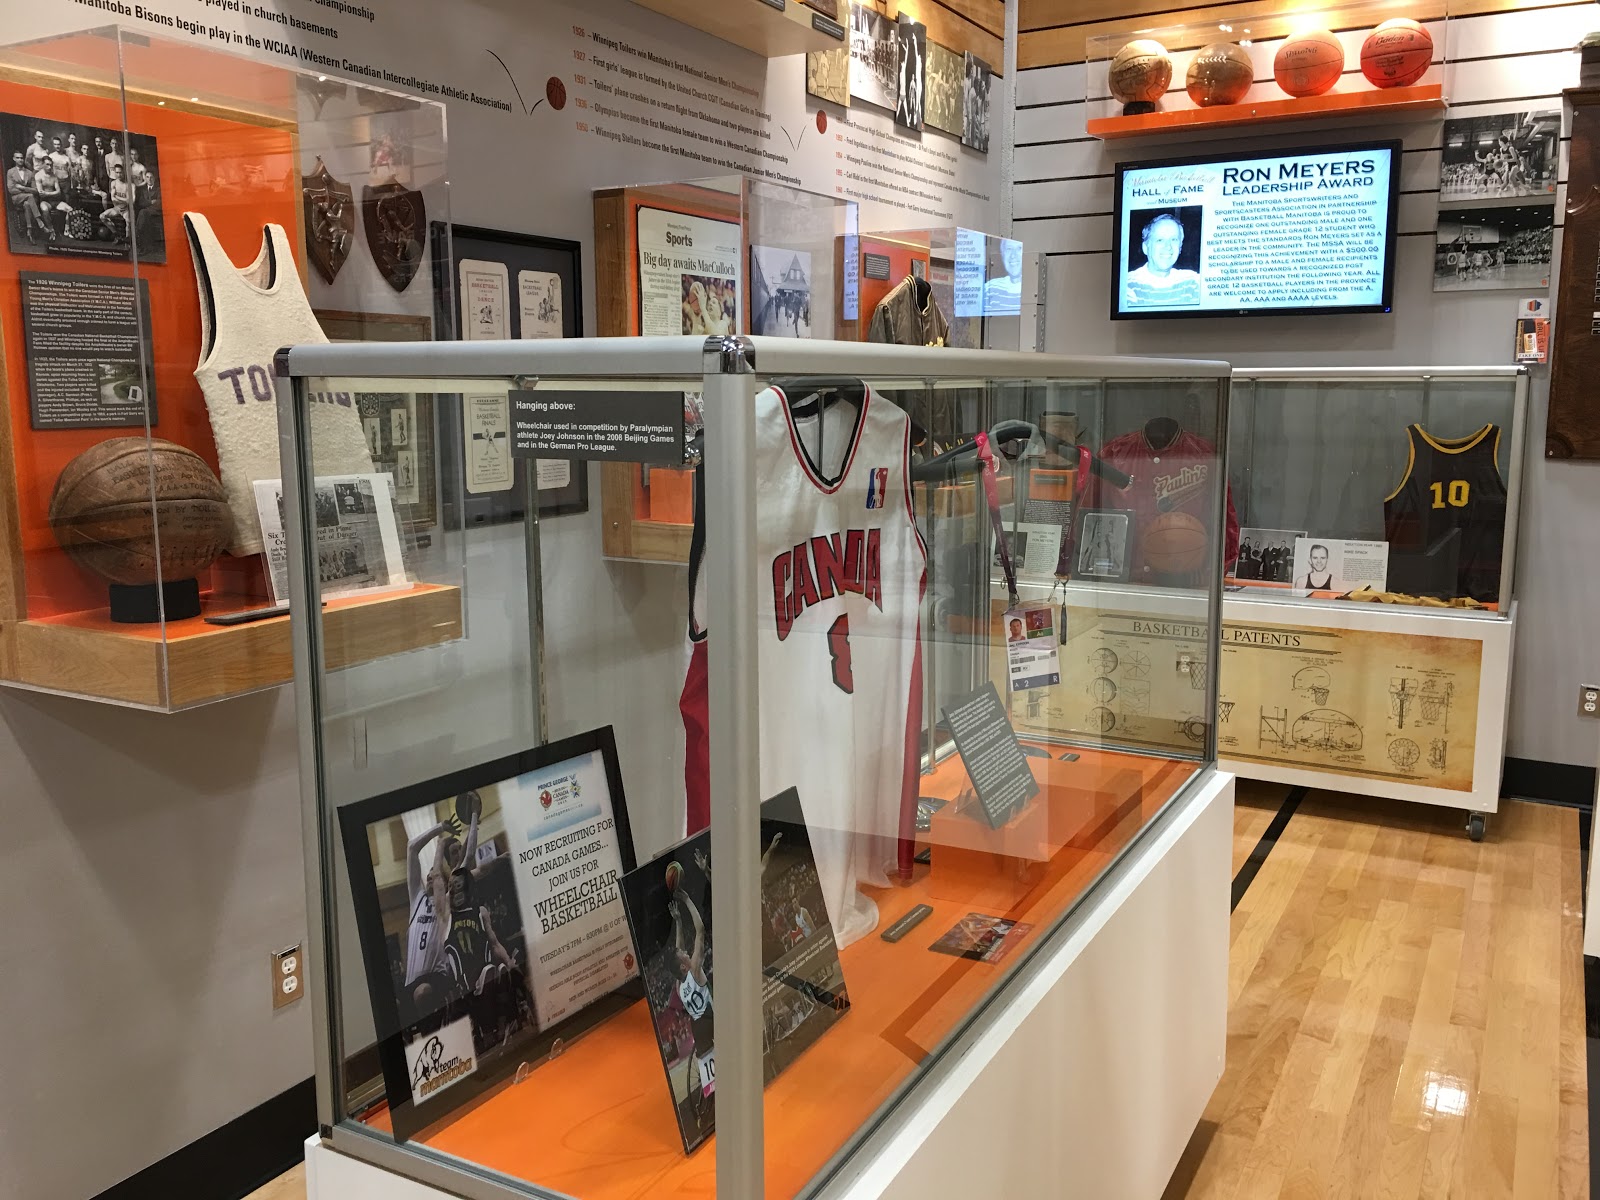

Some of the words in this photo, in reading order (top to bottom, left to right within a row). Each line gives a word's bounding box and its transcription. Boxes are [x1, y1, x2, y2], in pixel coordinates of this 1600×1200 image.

[242, 2, 251, 15] in
[255, 7, 287, 24] church
[290, 15, 338, 38] basements
[135, 5, 173, 26] Bisons
[176, 16, 206, 35] begin
[209, 26, 230, 43] play
[234, 31, 243, 44] in
[245, 35, 260, 48] the
[263, 38, 298, 58] WCIAA
[300, 47, 340, 69] (Western
[342, 59, 381, 79] Canadian
[383, 70, 439, 94] Intercollegiate
[441, 85, 469, 101] Athletic
[471, 93, 512, 113] Association)
[593, 32, 618, 51] Winnipeg
[619, 42, 636, 56] Toilers
[637, 50, 647, 59] win
[675, 61, 684, 72] first
[684, 65, 703, 78] National
[704, 72, 718, 83] Senior
[593, 56, 605, 67] First
[620, 65, 637, 78] league
[596, 126, 621, 143] Winnipeg
[642, 138, 661, 150] become
[670, 146, 679, 155] first
[680, 148, 701, 161] Manitoba
[701, 154, 712, 164] team
[713, 156, 717, 165] to
[734, 162, 752, 173] Canadian
[752, 168, 764, 176] Junior
[777, 172, 802, 186] Championship
[1223, 168, 1271, 184] RON
[1279, 160, 1375, 179] MEYERS
[1132, 188, 1161, 197] HALL
[1174, 185, 1204, 194] FAME
[1223, 181, 1313, 196] LEADERSHIP
[1318, 177, 1374, 189] AWARD
[1284, 195, 1342, 203] SPORTSWRITERS
[666, 231, 692, 247] Sports
[1346, 246, 1379, 254] $500.00
[644, 252, 656, 269] Big
[659, 254, 672, 271] day
[674, 258, 696, 271] awaits
[698, 259, 735, 276] MacCulloch
[516, 401, 548, 412] Hanging
[550, 402, 576, 410] above:
[516, 422, 552, 430] Wheelchair
[579, 424, 618, 433] competition
[620, 424, 628, 433] by
[630, 424, 673, 434] Paralympian
[540, 433, 555, 441] Joey
[557, 433, 585, 441] Johnson
[624, 434, 648, 444] Beijing
[650, 435, 674, 443] Games
[550, 442, 576, 450] German
[590, 444, 617, 452] League.
[1430, 480, 1470, 509] 10
[1133, 621, 1230, 640] BASKETBAL
[1234, 630, 1301, 647] PATENTS
[538, 782, 552, 791] PRINCE
[553, 776, 568, 786] GEORGE
[553, 790, 569, 798] CANADA
[519, 845, 543, 864] NOW
[544, 825, 596, 854] RECRUITING
[597, 818, 614, 833] FOR
[532, 853, 571, 877] CANADA
[572, 840, 609, 860] GAMES...
[549, 872, 569, 892] JOIN
[569, 867, 581, 880] US
[582, 859, 599, 875] FOR
[534, 869, 619, 919] WHEELCHAIR
[541, 887, 618, 935] BASKETBALL
[420, 932, 428, 950] 8
[540, 943, 570, 964] TUESDAY'S
[687, 991, 704, 1014] 10
[440, 1056, 459, 1073] team
[420, 1057, 472, 1097] manitoba
